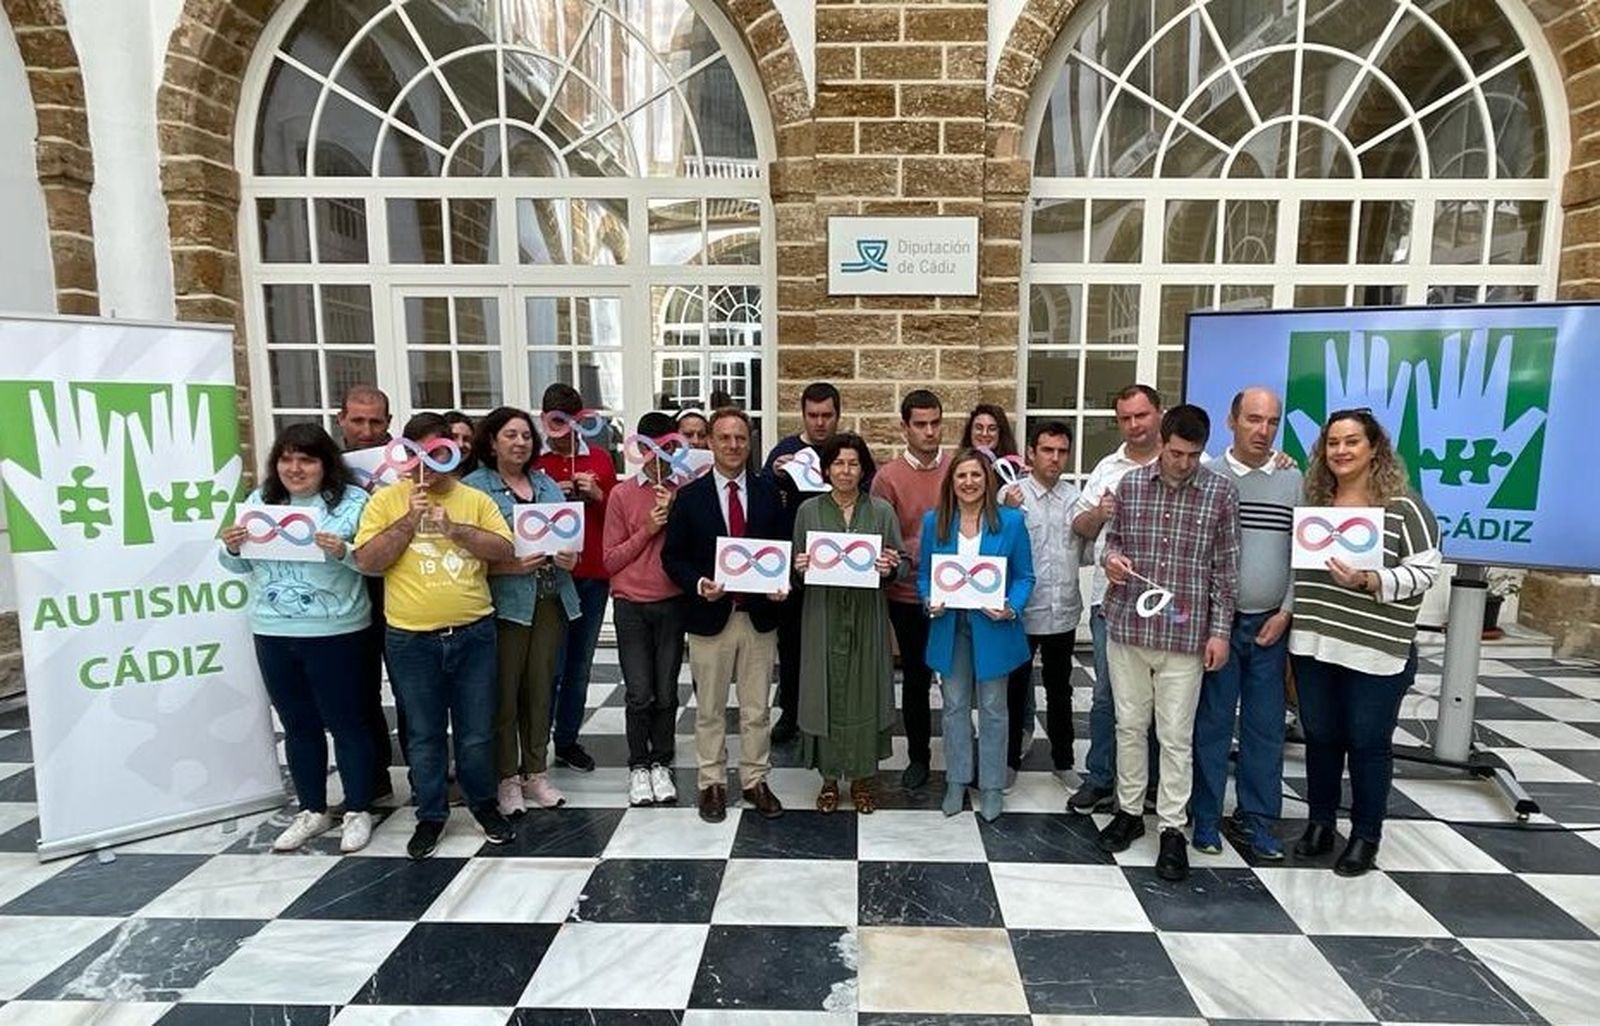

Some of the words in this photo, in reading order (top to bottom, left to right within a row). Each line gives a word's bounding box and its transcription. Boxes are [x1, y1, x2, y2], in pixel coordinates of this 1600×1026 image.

[898, 239, 970, 256] Diputación
[897, 260, 913, 274] de
[919, 259, 956, 274] Cádiz
[33, 580, 249, 631] AUTISMO
[79, 643, 224, 690] CÁDIZ
